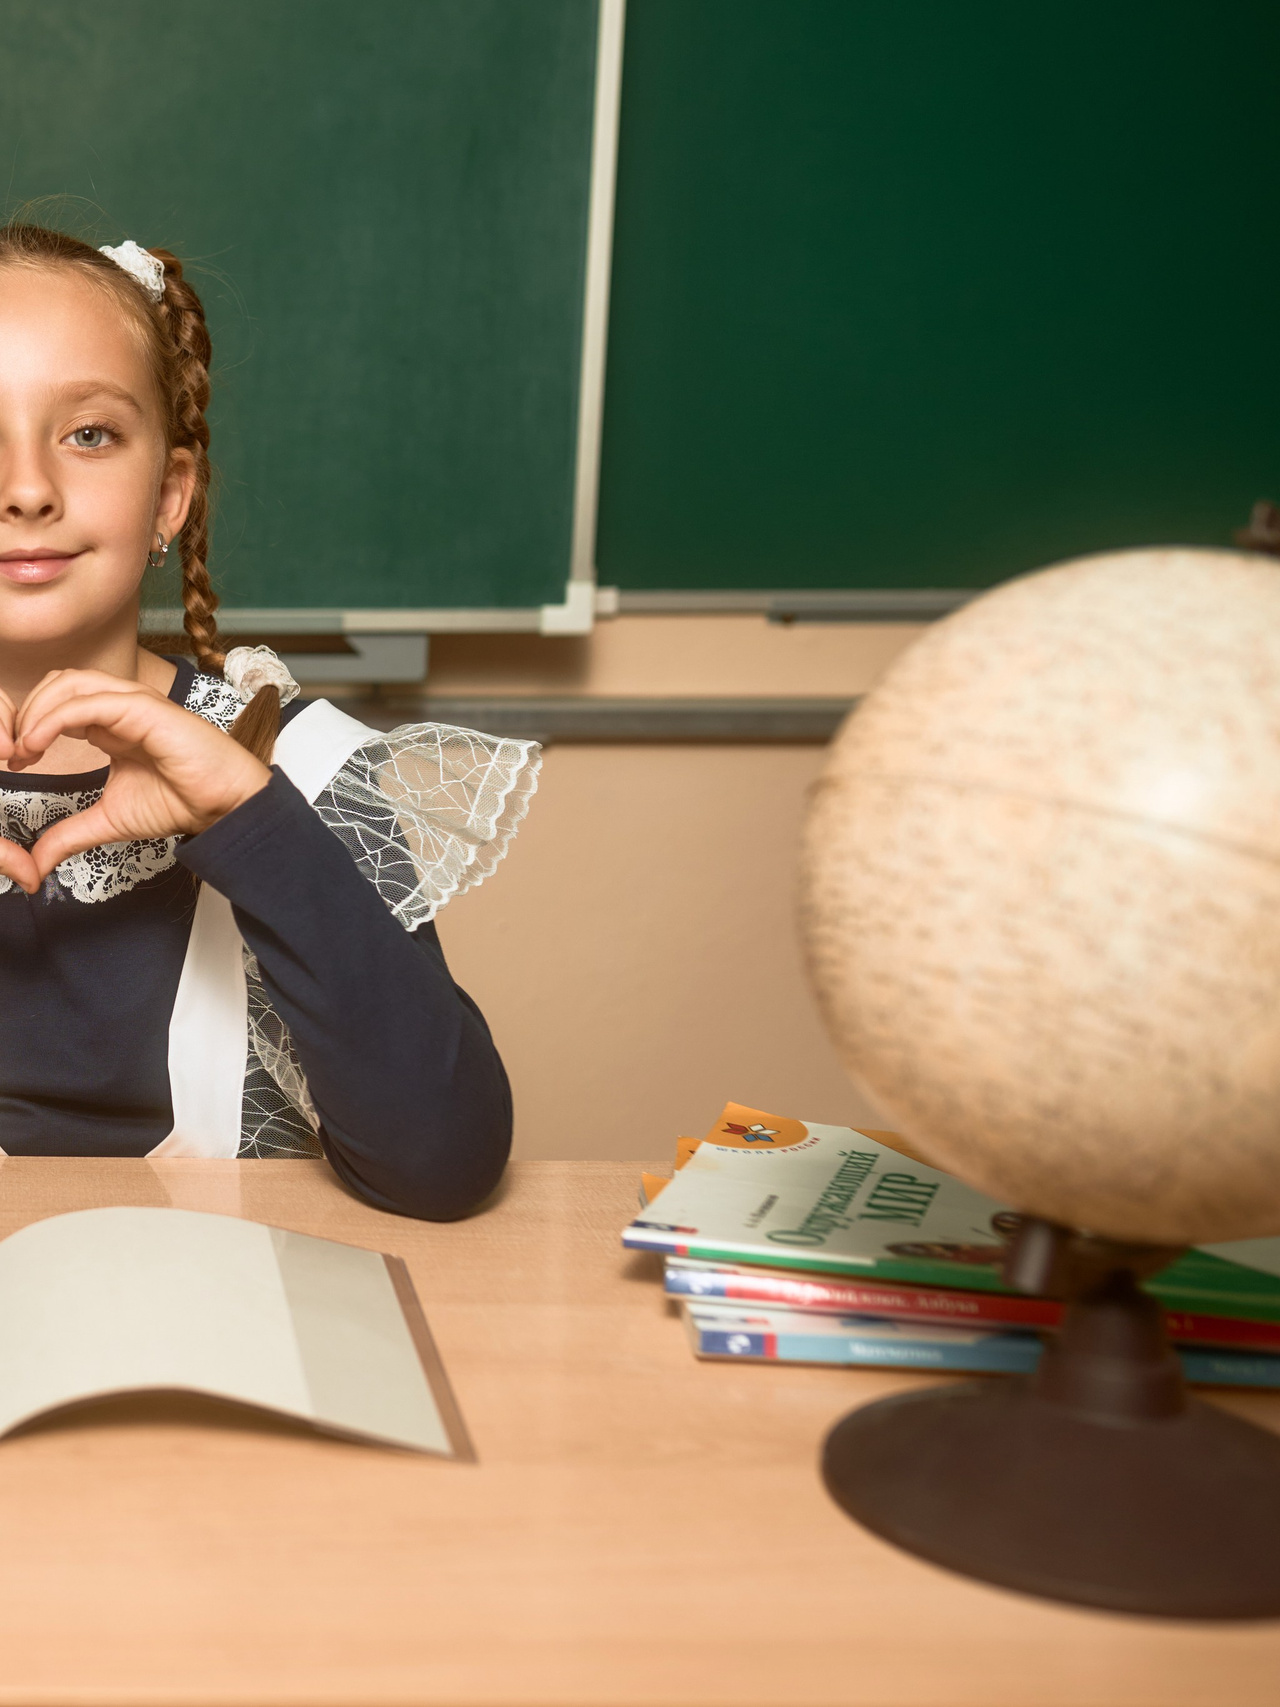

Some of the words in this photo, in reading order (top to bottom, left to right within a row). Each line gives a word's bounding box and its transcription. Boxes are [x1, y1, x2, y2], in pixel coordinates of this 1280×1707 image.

[716, 1146, 775, 1155] ШКОЛА
[765, 1149, 880, 1247] Окружающий
[858, 1172, 941, 1229] МИР
